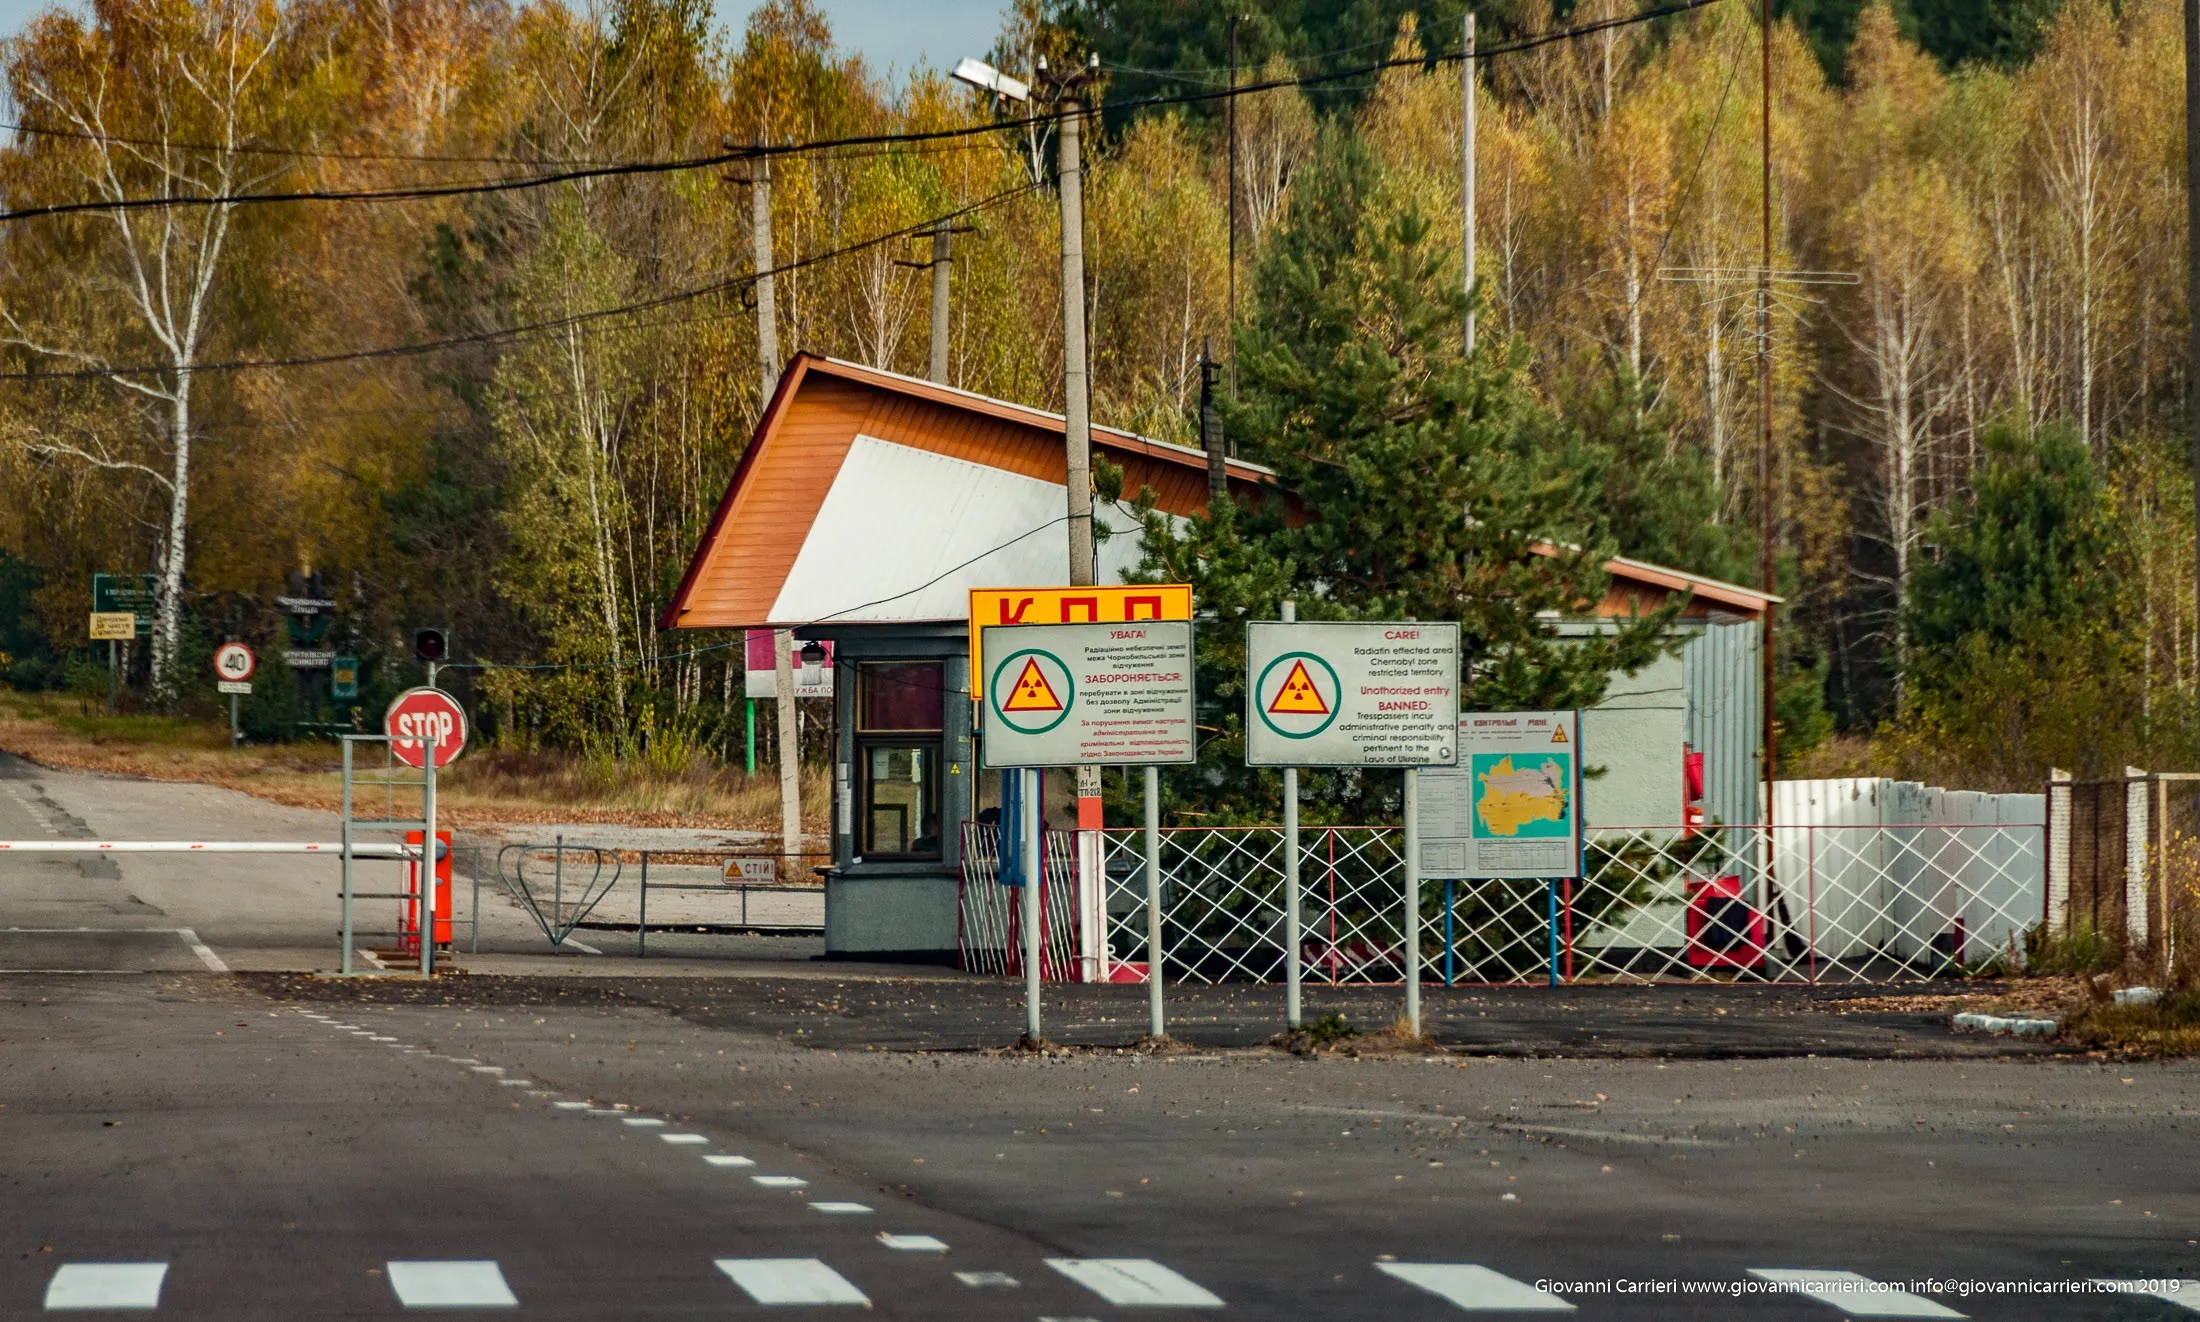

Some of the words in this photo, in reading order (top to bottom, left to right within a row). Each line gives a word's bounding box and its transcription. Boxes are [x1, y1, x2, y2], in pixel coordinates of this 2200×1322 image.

[1110, 631, 1146, 639] УВАГА!
[1384, 631, 1420, 640] CARE!
[224, 653, 246, 671] 40
[1371, 658, 1415, 666] Chernobyl
[1085, 673, 1183, 683] ЗАБОРОНЯЄТЬСЯ:
[793, 686, 818, 694] УЖБА
[1423, 686, 1450, 696] entry
[1378, 701, 1432, 711] BANNED:
[399, 712, 453, 749] STOP
[1402, 724, 1434, 732] penalty
[1363, 745, 1402, 753] pertinent
[745, 861, 774, 874] СТІЙ!
